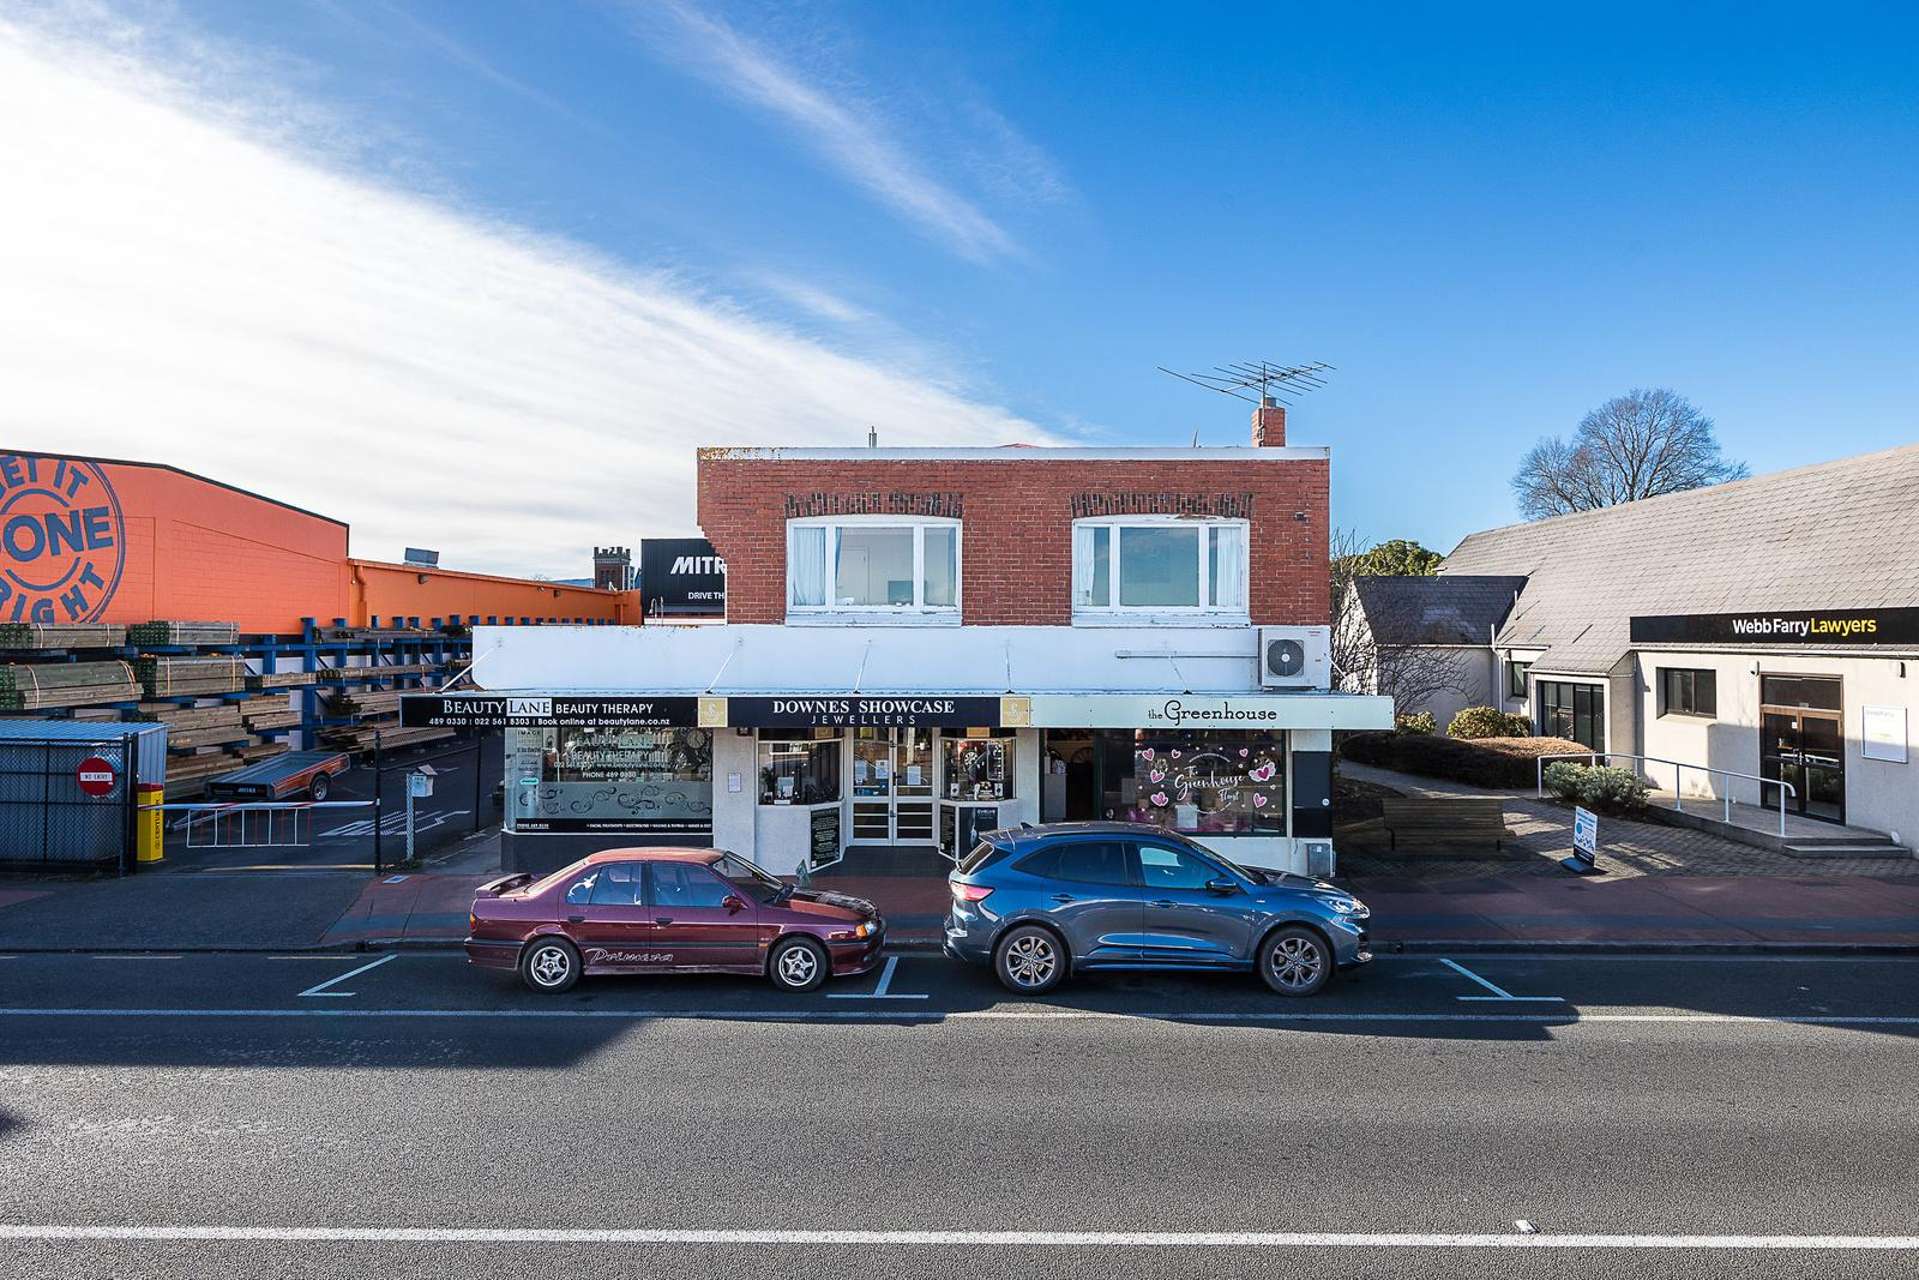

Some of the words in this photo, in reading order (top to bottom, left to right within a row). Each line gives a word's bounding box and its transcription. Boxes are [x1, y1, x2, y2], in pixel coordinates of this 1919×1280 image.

[0, 456, 37, 499] ET
[53, 458, 90, 499] IT
[0, 506, 113, 562] ONE
[687, 592, 712, 600] DRIVE
[1810, 617, 1877, 637] Lawyers
[443, 699, 505, 714] BEAUTY
[508, 700, 551, 714] LANE
[555, 704, 599, 714] BEAUTY
[602, 704, 654, 714] THERAPY
[772, 700, 850, 714] DOWNES
[858, 700, 956, 714] SHOWCASE
[1148, 709, 1163, 720] the
[1164, 700, 1278, 727] Greenhouse
[428, 718, 444, 726] 489
[446, 718, 467, 726] 0330
[474, 718, 490, 726] 022
[492, 718, 507, 726] 561
[537, 717, 558, 726] Book
[559, 717, 585, 726] online
[587, 718, 597, 726] at
[598, 717, 670, 727] beautylane.co.nz
[810, 714, 917, 725] JEWELLERS
